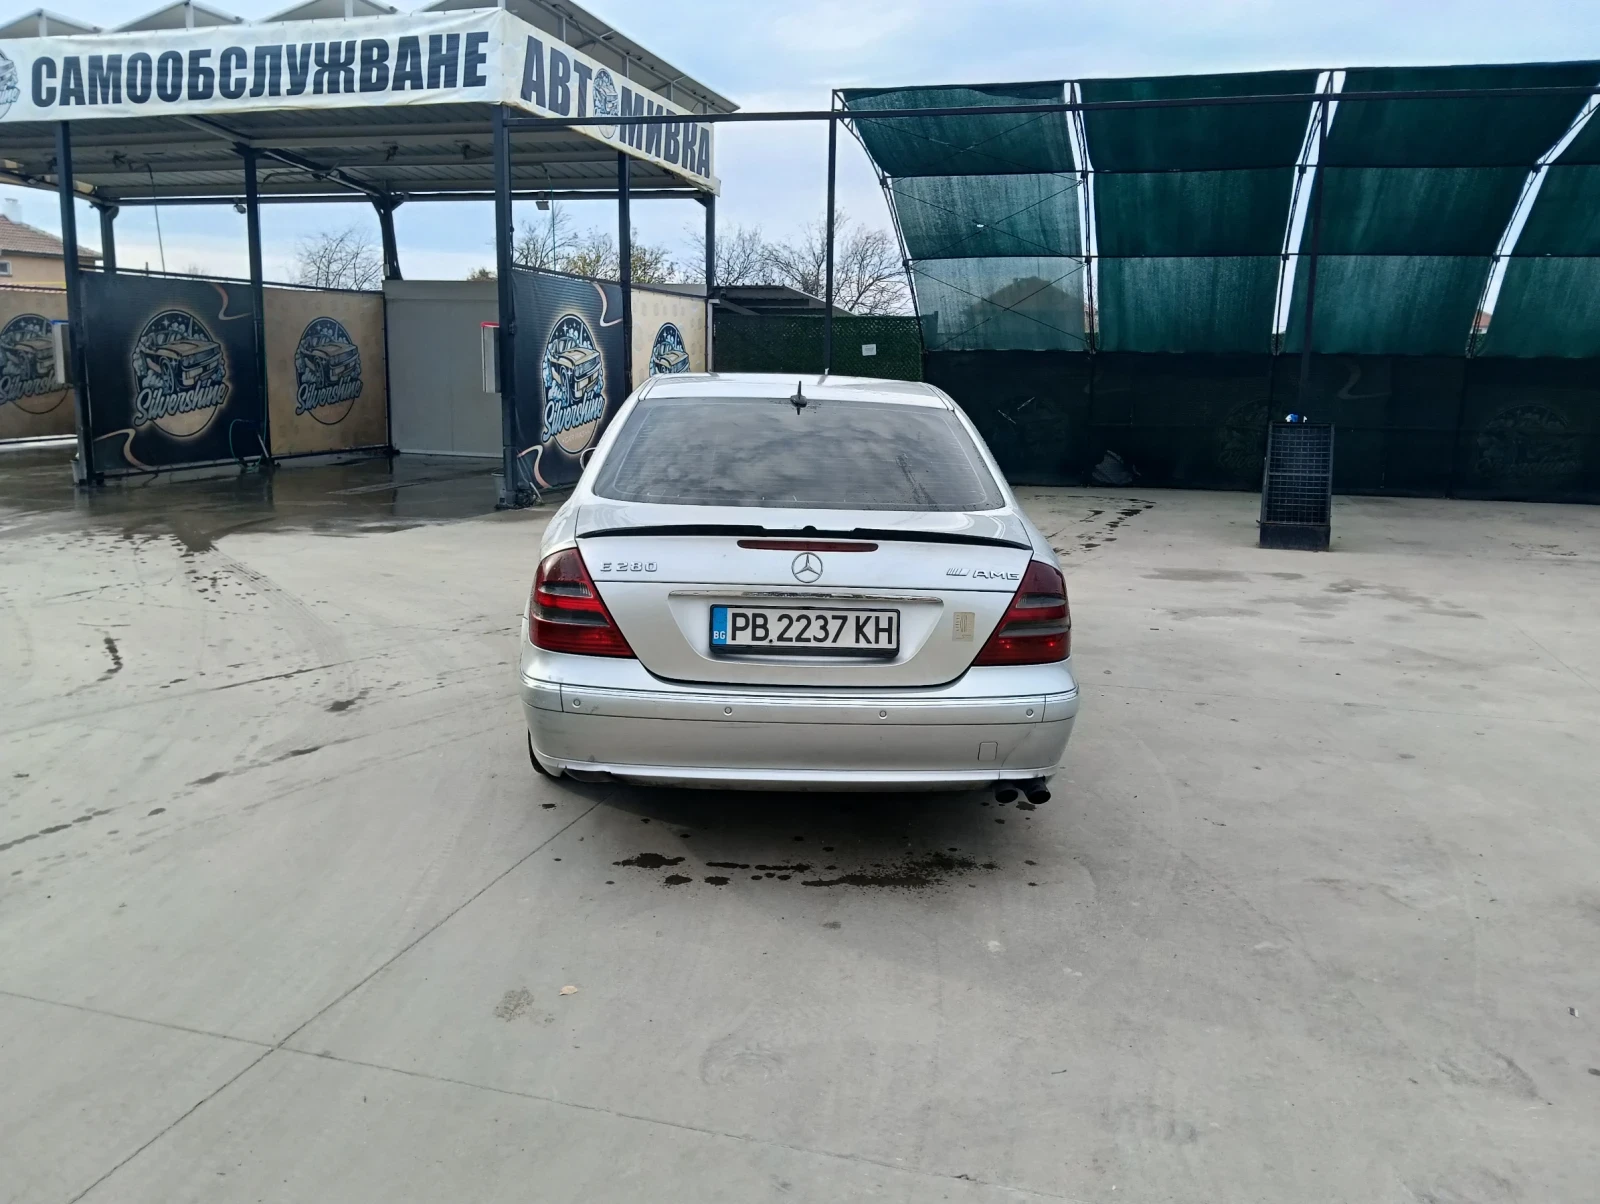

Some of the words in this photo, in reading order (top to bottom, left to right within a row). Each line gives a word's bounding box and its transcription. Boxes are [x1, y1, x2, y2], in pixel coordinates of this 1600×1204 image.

[31, 32, 489, 108] САМООБСЛУЖВАНЕ
[133, 378, 229, 426] Silvershine
[295, 375, 363, 416] Silvershine
[542, 391, 605, 442] Silvershine
[600, 562, 612, 572] E
[616, 562, 657, 573] 280
[973, 570, 1020, 581] AMG
[713, 631, 726, 640] BG
[776, 614, 848, 644] 2237
[855, 615, 893, 645] KH
